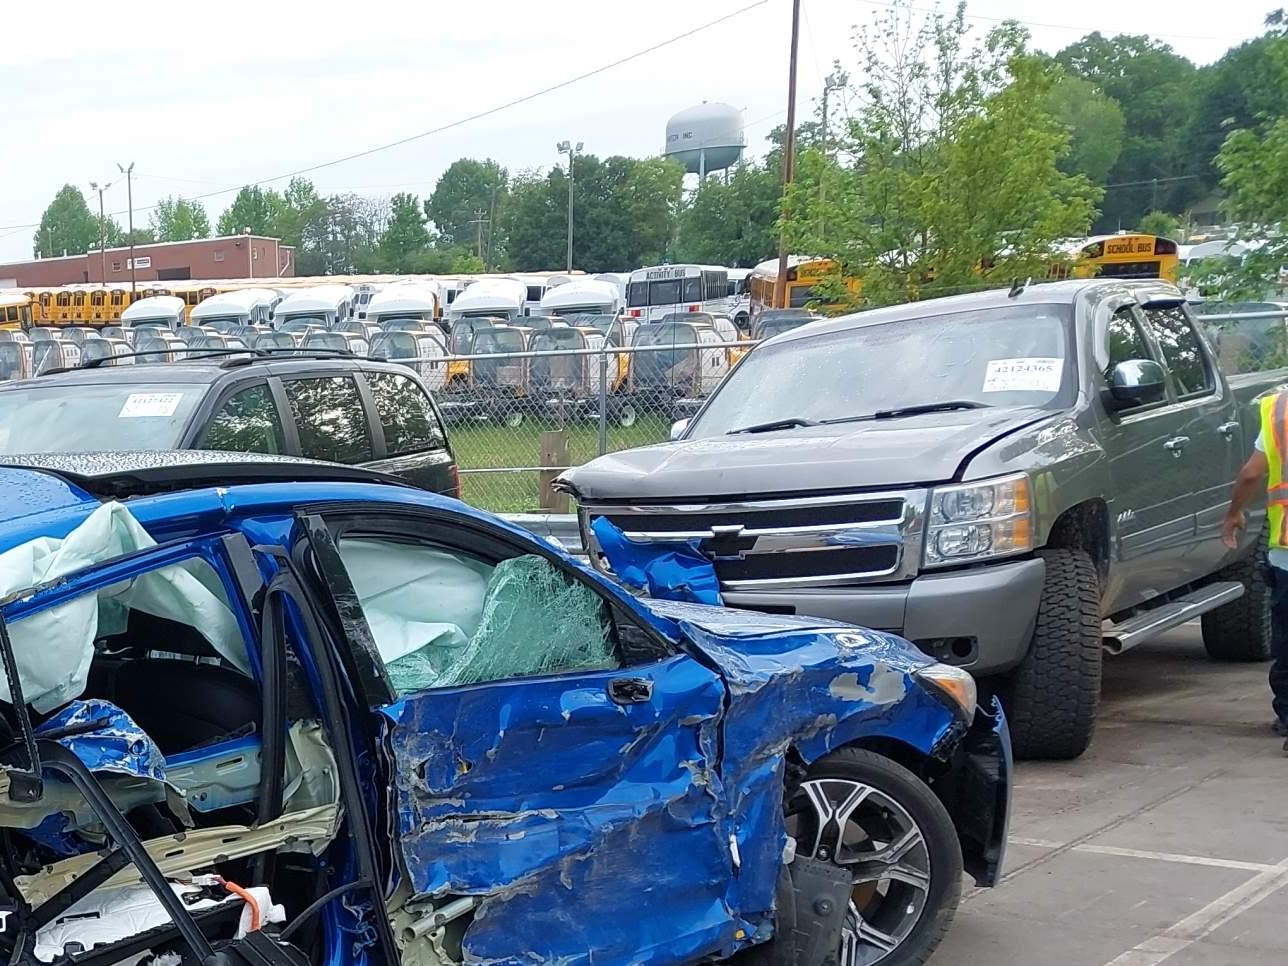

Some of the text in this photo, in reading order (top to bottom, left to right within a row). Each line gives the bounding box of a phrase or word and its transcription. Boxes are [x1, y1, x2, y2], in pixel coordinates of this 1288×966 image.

[1107, 242, 1152, 254] SCHOOL BUS
[646, 268, 686, 280] ACTIVITY BUS
